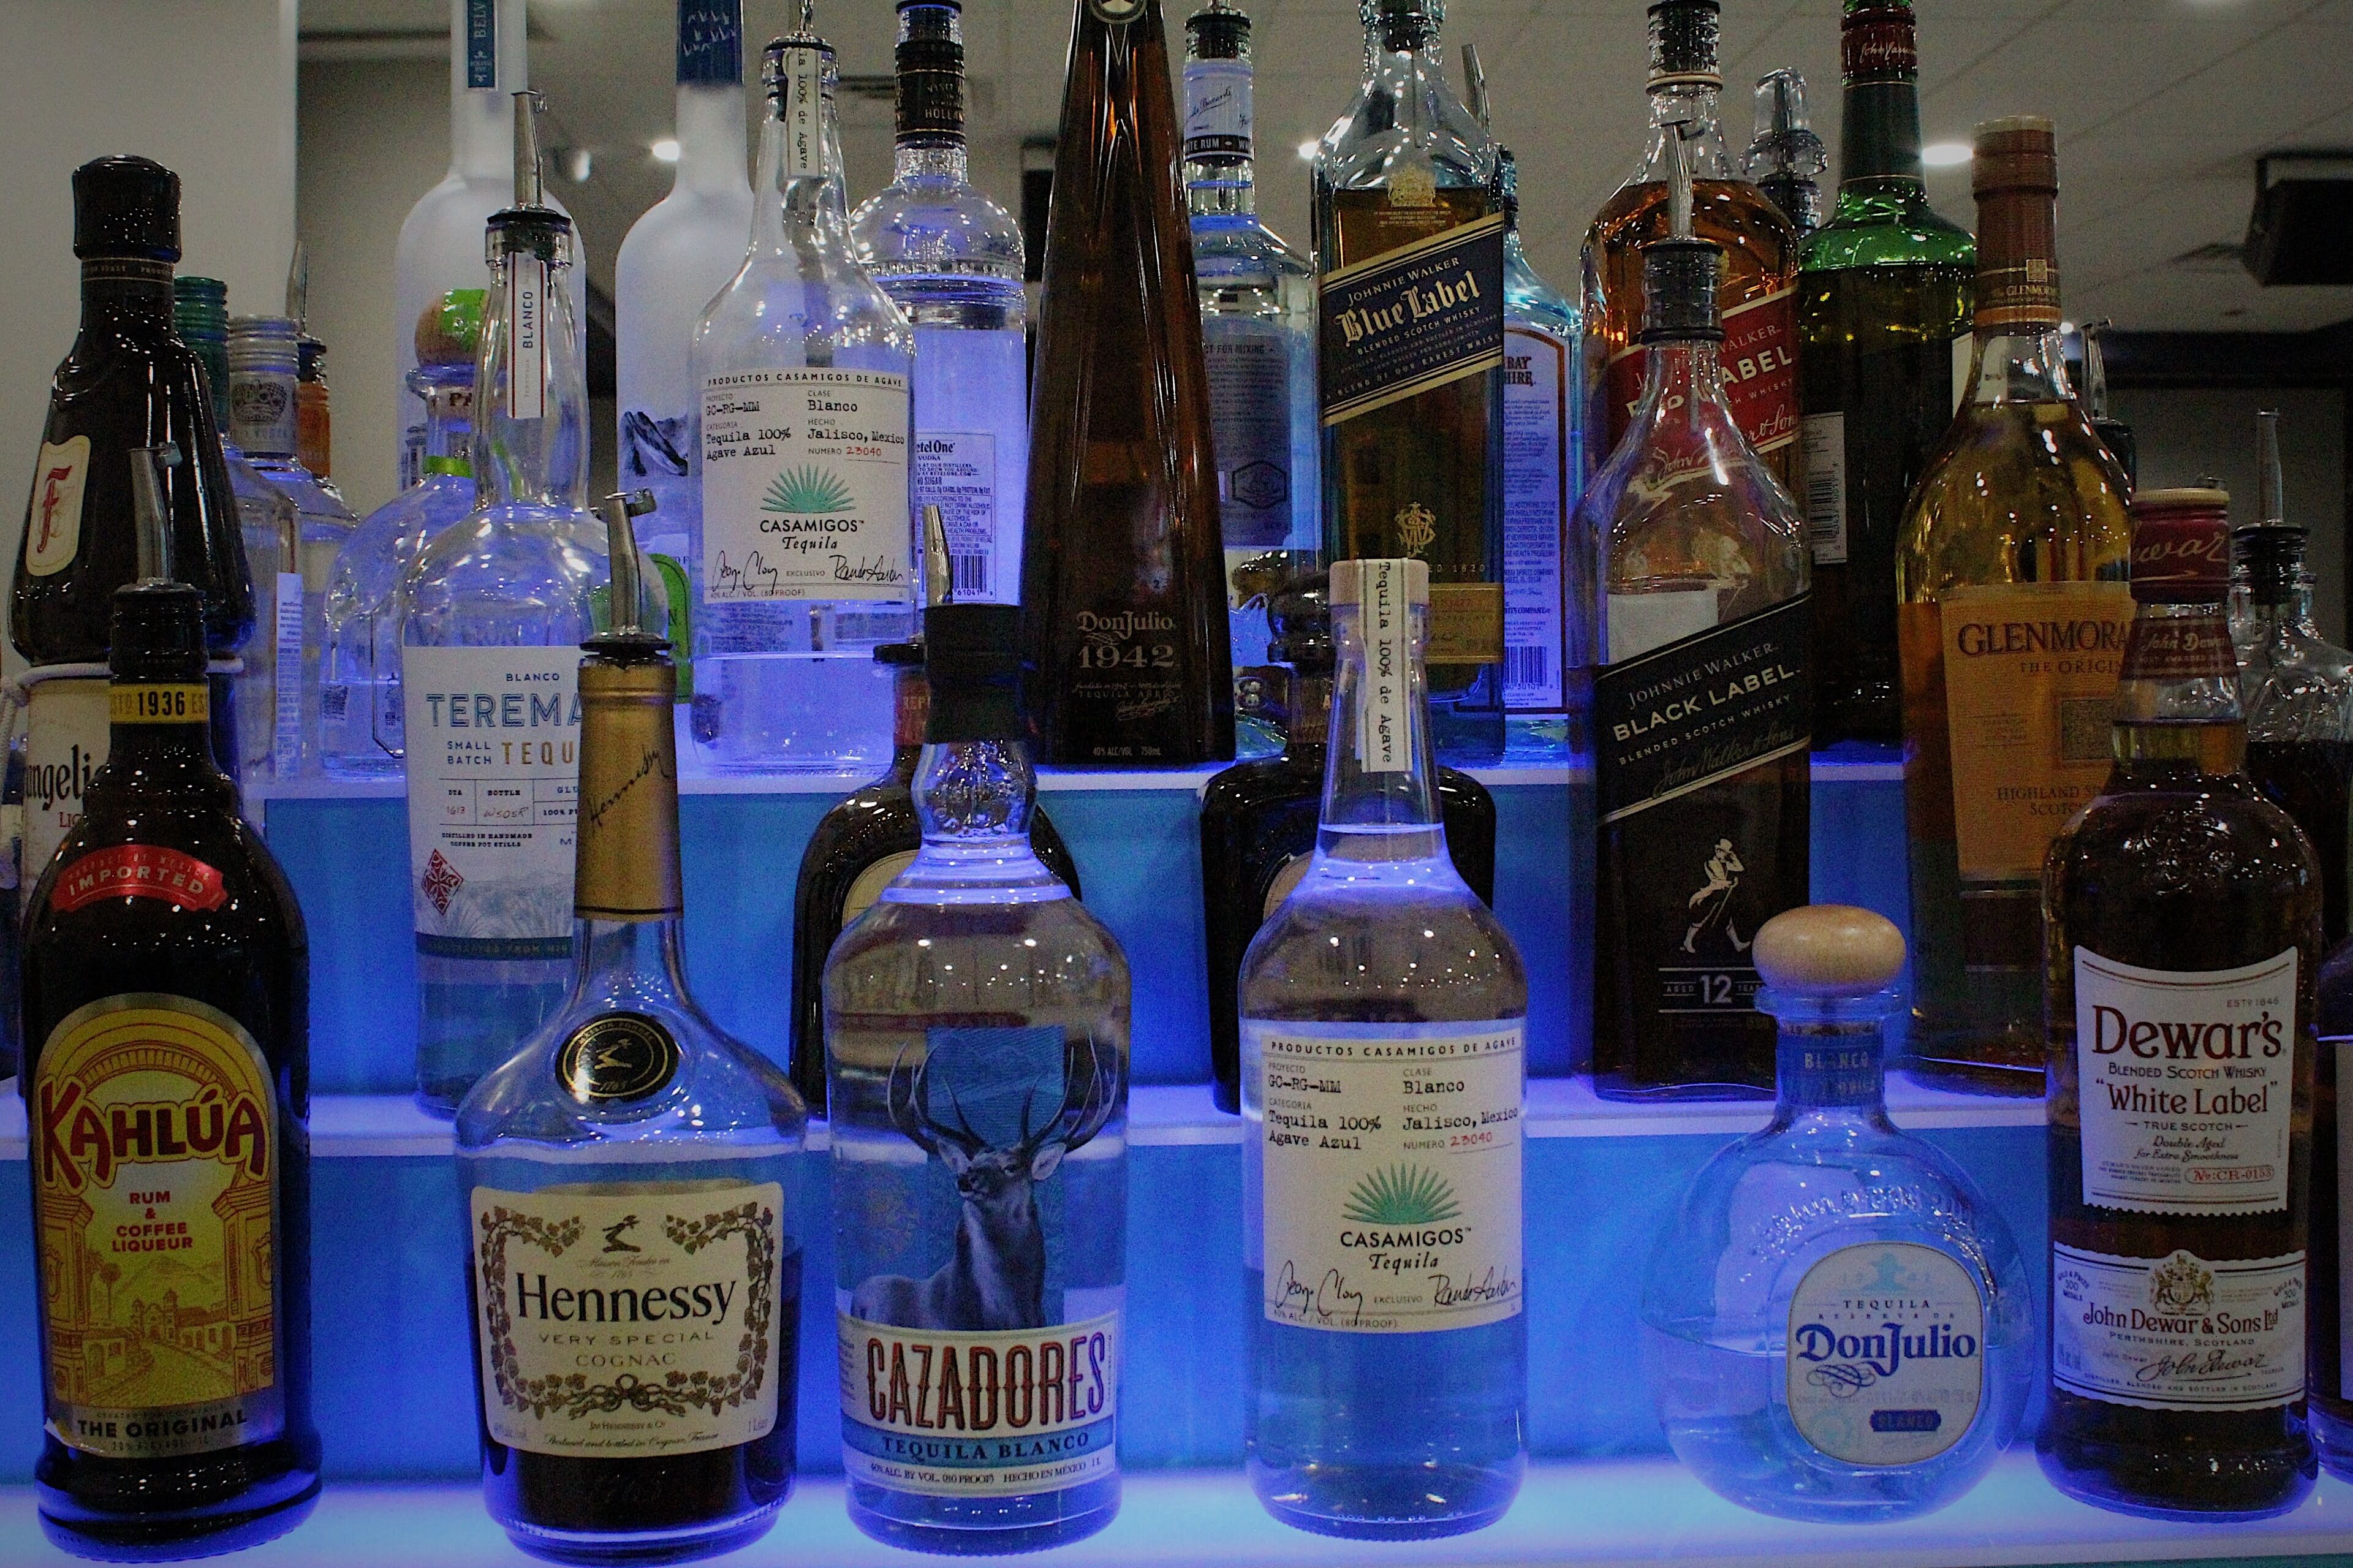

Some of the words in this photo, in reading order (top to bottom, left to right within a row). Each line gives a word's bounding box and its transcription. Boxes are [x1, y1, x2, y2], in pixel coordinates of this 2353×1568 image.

[798, 74, 808, 104] 100%
[798, 111, 808, 124] de
[797, 132, 808, 169] Agave
[1200, 138, 1219, 148] RUM
[1348, 276, 1406, 306] JOHNNIE
[1407, 257, 1461, 281] WALKER
[1335, 302, 1405, 347] Blue
[1400, 270, 1482, 324] Label
[523, 291, 533, 349] BLANCO
[1358, 335, 1400, 355] BLENDED
[1404, 320, 1440, 339] SCOTCH
[1444, 306, 1480, 324] WHISKY
[1721, 346, 1793, 385] ABEL
[708, 374, 769, 387] PRODUCTOS
[875, 376, 902, 387] AGAVE
[808, 400, 858, 412] Blanco
[707, 429, 750, 445] Tequila
[758, 428, 792, 441] 100%
[808, 429, 868, 444] Jalisco,
[872, 431, 905, 445] Mexico
[706, 447, 737, 461] Agave
[743, 445, 776, 456] Azul
[846, 447, 882, 457] 23040
[917, 440, 933, 453] etel
[933, 440, 954, 453] One
[924, 477, 942, 485] SUGAR
[760, 519, 858, 533] CASAMIGOS
[782, 536, 838, 554] Tequila
[1375, 562, 1391, 629] Tequila
[1077, 610, 1126, 632] Don
[1958, 621, 2126, 658] GLENMORA
[1078, 645, 1175, 668] 1942
[1376, 640, 1393, 678] 100%
[1628, 669, 1702, 710] JOHNNIE
[1705, 642, 1774, 675] WALKER
[2021, 661, 2051, 673] THE
[506, 673, 560, 681] BLANCO
[137, 691, 185, 716] 1936
[1380, 686, 1392, 704] de
[1612, 695, 1703, 742] BLACK
[1708, 664, 1795, 706] LABEL
[426, 693, 582, 727] TEREMA
[1378, 714, 1392, 763] Agave
[1618, 737, 1679, 766] BLENDED
[1685, 714, 1735, 740] SCOTCH
[1741, 694, 1792, 719] WHISKY
[447, 741, 491, 751] SMALL
[502, 741, 574, 765] TEQU
[447, 756, 492, 765] BATCH
[69, 866, 204, 896] IMPORTED
[1699, 974, 1733, 1004] 12
[2092, 1005, 2283, 1059] Dewar's
[1271, 1042, 1353, 1056] PRODUCTOS
[1364, 1045, 1455, 1056] CASAMIGOS
[1464, 1044, 1478, 1053] DE
[1485, 1037, 1516, 1050] AGAVE
[1268, 1062, 1306, 1074] PROYECTO
[1403, 1068, 1433, 1077] CLASE
[2109, 1062, 2162, 1078] BLENDED
[2167, 1066, 2219, 1079] SCOTCH
[2224, 1066, 2267, 1079] WHISKY
[1403, 1080, 1465, 1095] Blanco
[1403, 1103, 1438, 1113] HECHO
[1269, 1110, 1329, 1130] Tequila
[1338, 1115, 1382, 1133] 100%
[1403, 1116, 1477, 1131] Jalisco,
[1480, 1107, 1519, 1124] Mexico
[2144, 1121, 2176, 1131] TRUE
[2180, 1121, 2234, 1132] SCOTCH
[40, 1081, 266, 1189] KAHLÚA
[1269, 1129, 1309, 1147] Agave
[1319, 1136, 1362, 1151] Azul
[1403, 1140, 1446, 1150] NUMERO
[1450, 1132, 1493, 1146] 23040
[2153, 1136, 2193, 1149] Double
[2196, 1136, 2225, 1151] Aged
[2151, 1148, 2180, 1161] Extra
[129, 1191, 171, 1205] RUM
[145, 1207, 156, 1219] &
[116, 1222, 188, 1237] COFFEE
[1340, 1228, 1464, 1248] CASAMIGOS
[112, 1237, 192, 1252] LIQUEUR
[1369, 1252, 1439, 1275] Tequila
[516, 1273, 737, 1325] Hennessy
[1843, 1300, 1930, 1310] TEQUILA
[2083, 1302, 2128, 1328] John
[2131, 1309, 2198, 1334] Dewar
[2202, 1317, 2214, 1335] &
[2217, 1312, 2261, 1335] Sons
[540, 1332, 597, 1346] VERY
[610, 1331, 715, 1346] SPECIAL
[2109, 1331, 2189, 1347] PERTHSHIRE,
[2194, 1338, 2256, 1347] SCOTLAND
[1795, 1324, 1887, 1362] Don
[1868, 1322, 1976, 1377] Julio
[575, 1352, 676, 1368] COGNAC
[868, 1331, 1105, 1431] CAZADORES
[77, 1419, 117, 1439] THE
[126, 1409, 248, 1439] ORIGINAL
[882, 1437, 987, 1462] TEQUILA
[999, 1432, 1089, 1459] BLANCO
[904, 1471, 915, 1480] BY
[919, 1472, 939, 1482] VOL.
[959, 1473, 994, 1484] PROOF)
[1003, 1471, 1040, 1483] HECHO
[1041, 1469, 1053, 1479] EN
